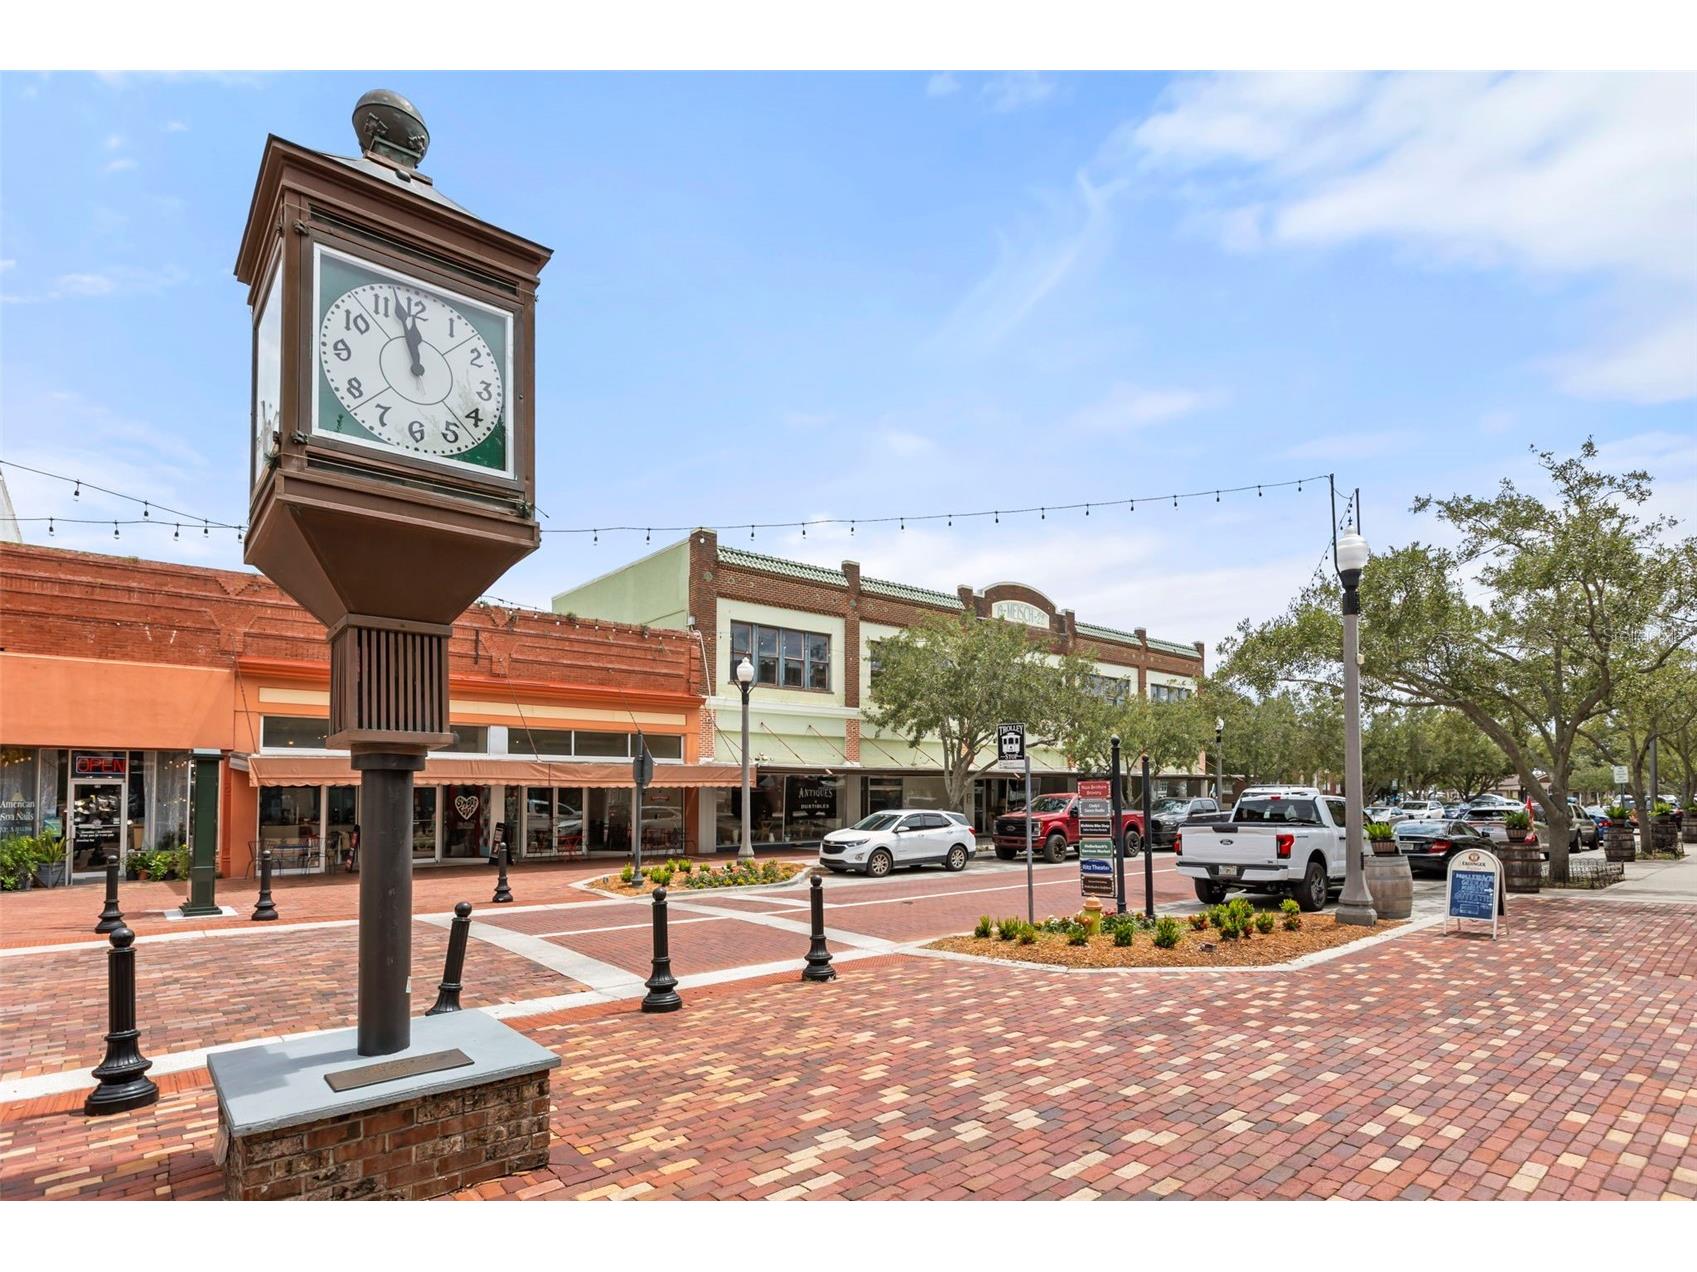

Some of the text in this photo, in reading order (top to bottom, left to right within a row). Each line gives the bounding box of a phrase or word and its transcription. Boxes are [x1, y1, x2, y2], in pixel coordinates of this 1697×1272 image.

[373, 293, 389, 318] 11
[407, 296, 429, 321] 12
[344, 308, 370, 335] 10
[449, 317, 455, 338] 1
[333, 338, 351, 361] 9
[470, 347, 484, 368] 2
[346, 376, 363, 399] 8
[476, 380, 492, 401] 3
[375, 403, 392, 427] 7
[465, 407, 484, 428] 4
[408, 420, 425, 443] 6
[441, 421, 460, 444] 5
[999, 725, 1023, 736] TROLLEY
[77, 758, 126, 773] OPEN
[798, 786, 833, 799] ANTIQUES
[0, 800, 35, 809] American
[0, 811, 34, 822] Spa Nails
